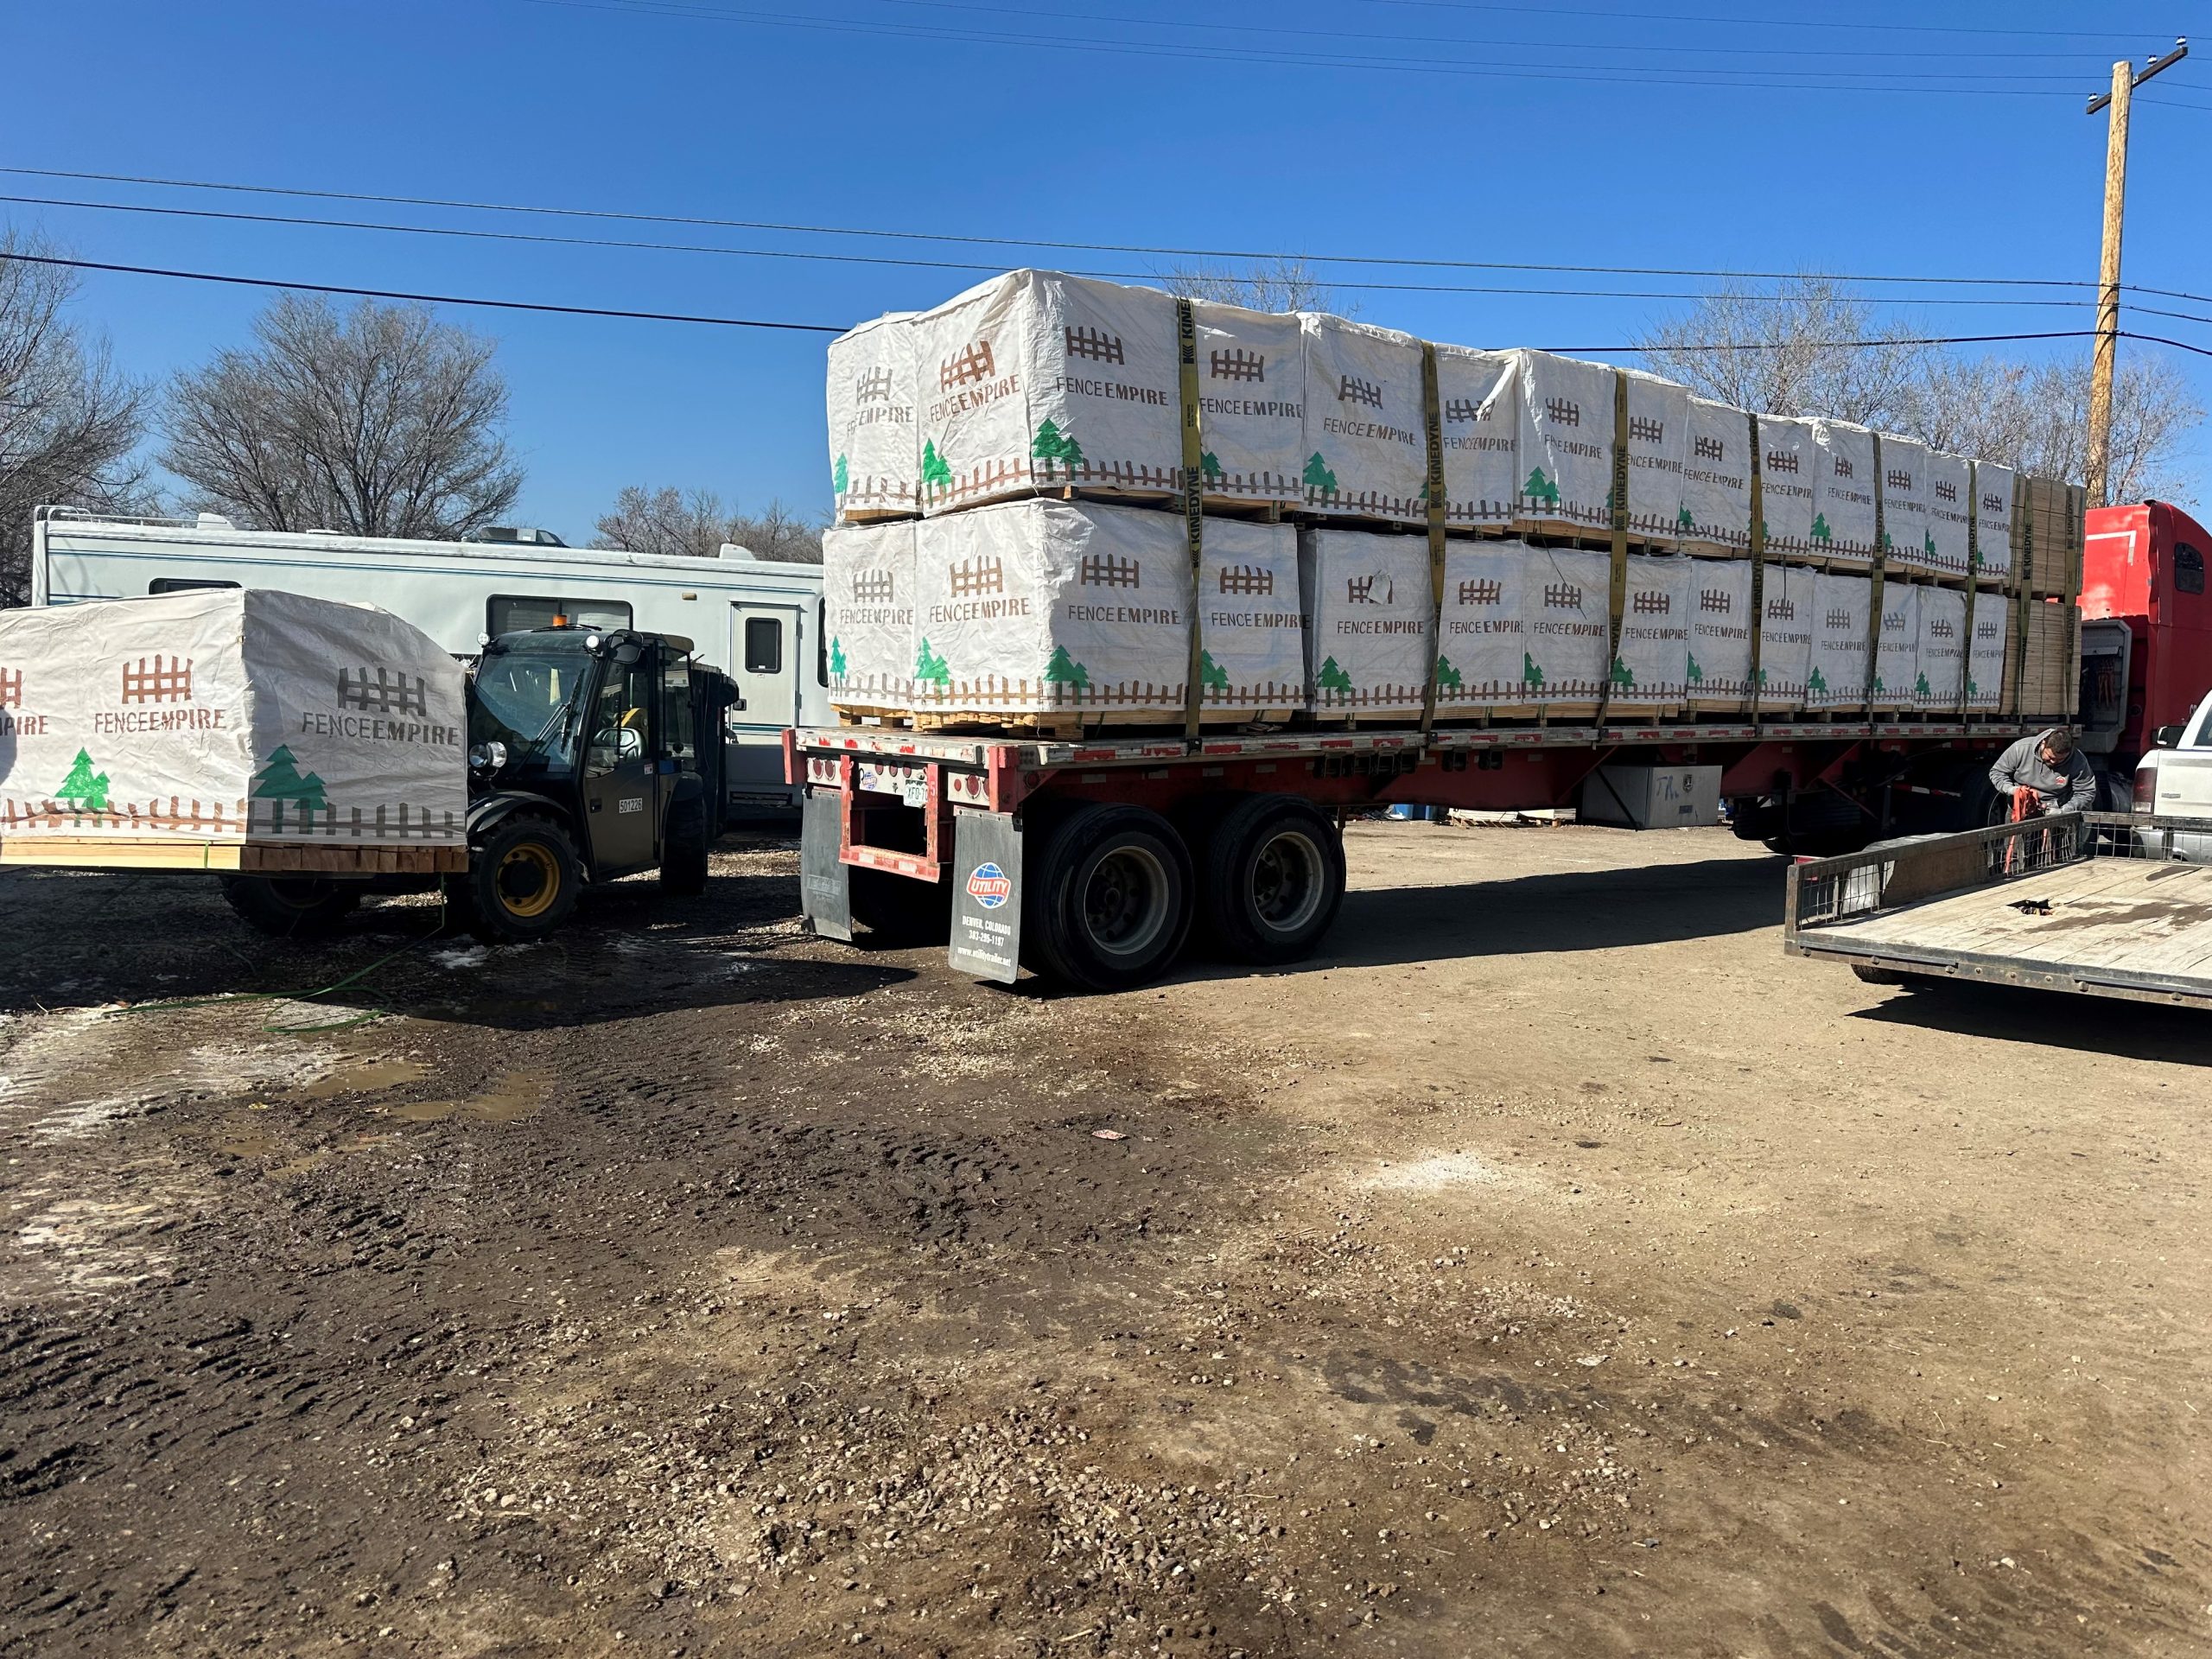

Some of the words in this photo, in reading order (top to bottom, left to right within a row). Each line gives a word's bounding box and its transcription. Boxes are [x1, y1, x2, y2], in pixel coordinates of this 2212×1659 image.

[1428, 412, 1441, 485] KINEDYNE
[1614, 444, 1625, 511] KINEDYNE
[1186, 466, 1200, 543] KINEDYNE
[2023, 524, 2031, 566] KINEDYNE
[1752, 550, 1762, 609] KINEDYNE
[620, 799, 642, 812] 501226
[971, 880, 1008, 893] UTILITY
[962, 915, 983, 929] DENVER,
[985, 920, 1011, 936] COLORADO
